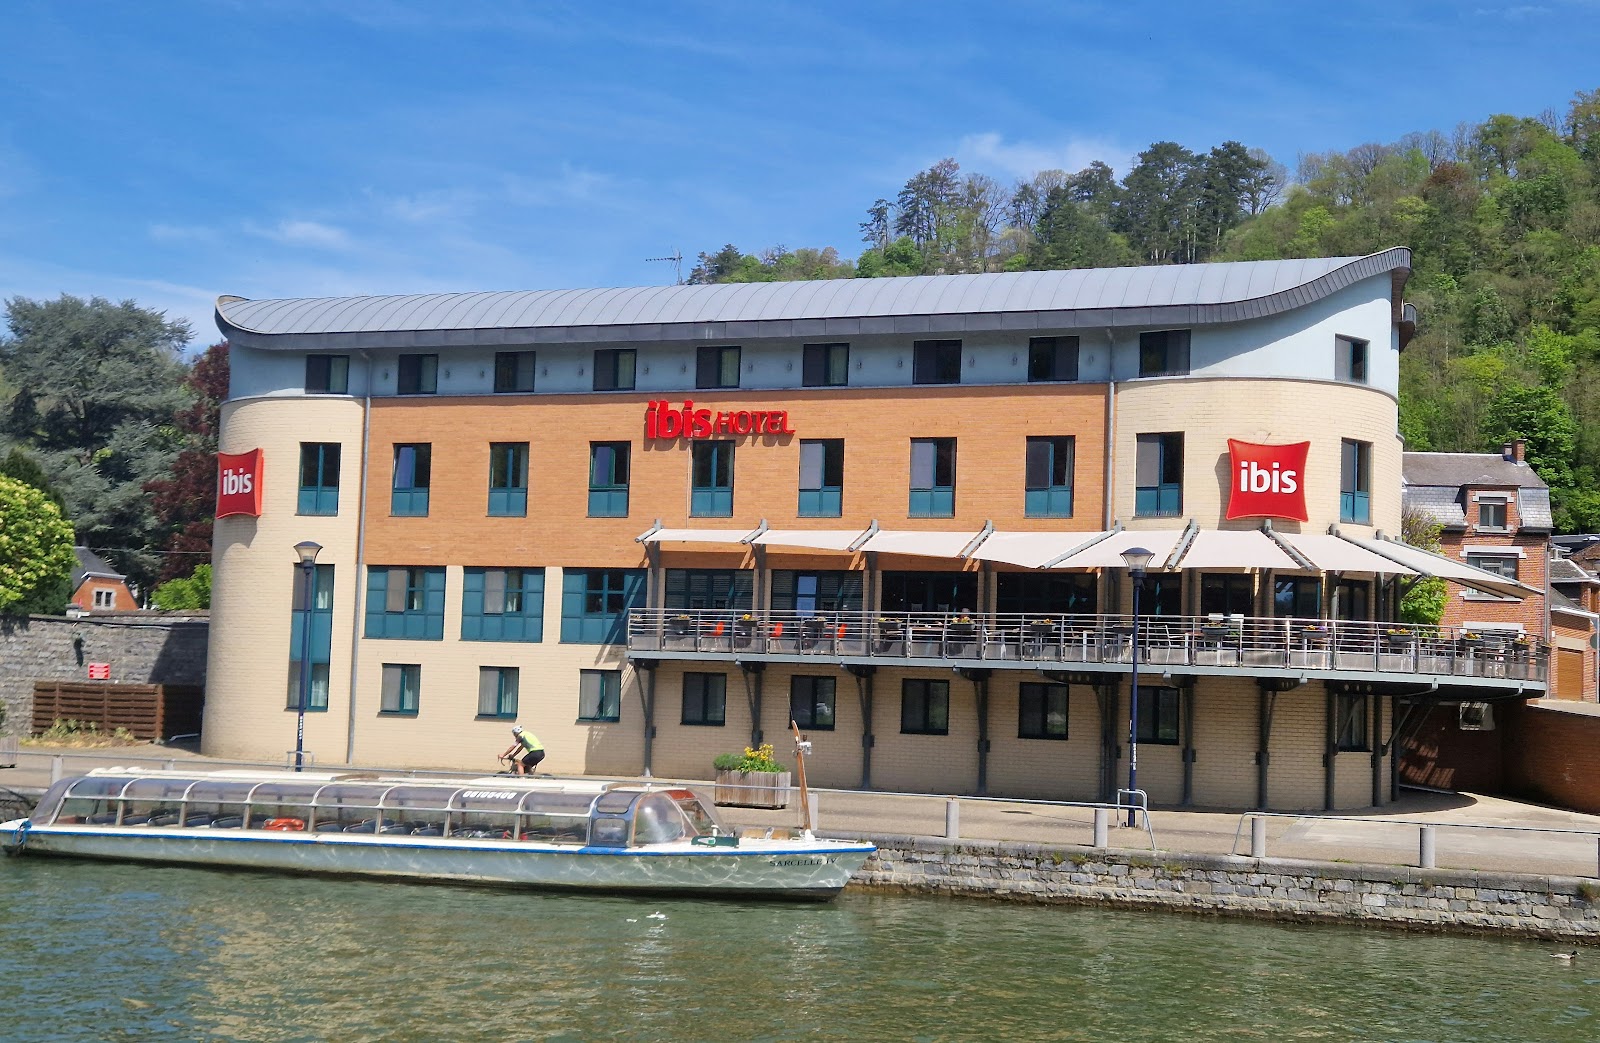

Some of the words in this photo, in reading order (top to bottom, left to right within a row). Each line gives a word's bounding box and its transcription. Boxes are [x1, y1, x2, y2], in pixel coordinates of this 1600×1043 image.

[647, 400, 712, 438] ibis
[717, 410, 796, 434] HOTEL
[223, 467, 252, 496] ibis
[1240, 461, 1297, 494] ibis
[769, 859, 823, 867] SARCELLE
